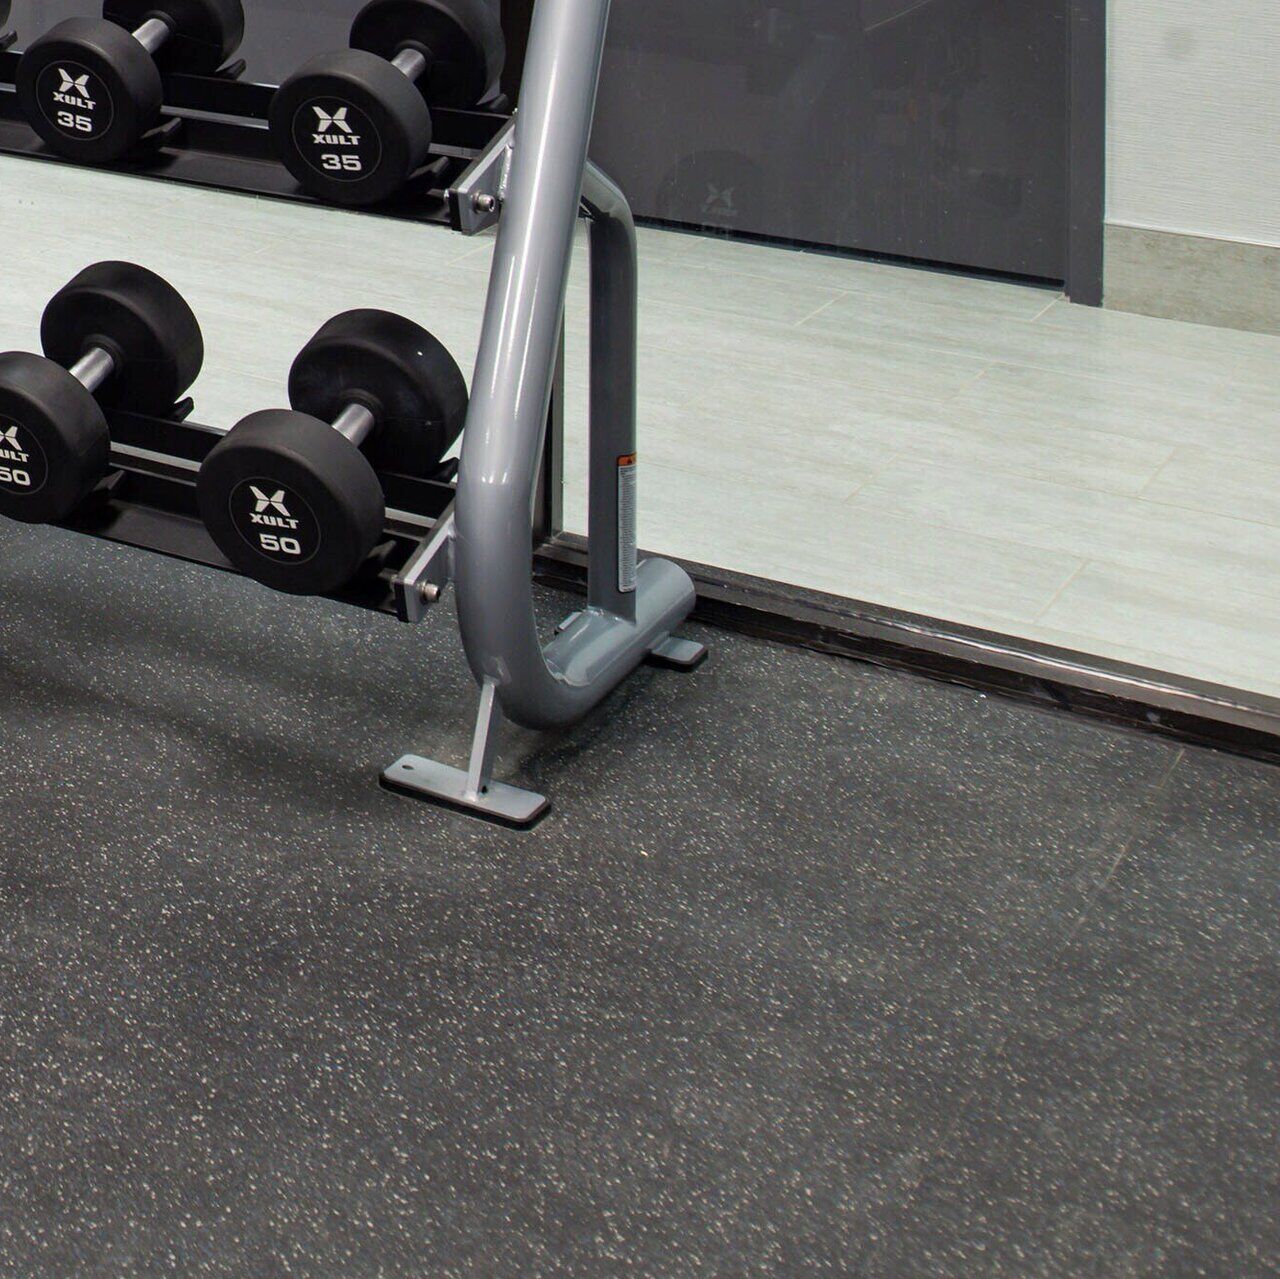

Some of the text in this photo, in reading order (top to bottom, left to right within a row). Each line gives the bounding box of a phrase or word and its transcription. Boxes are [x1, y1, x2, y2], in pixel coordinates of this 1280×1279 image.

[53, 92, 96, 110] XULT
[58, 111, 92, 132] 35
[312, 134, 360, 145] XULT
[321, 154, 361, 171] 35
[250, 513, 299, 529] XULT
[260, 533, 301, 554] 50
